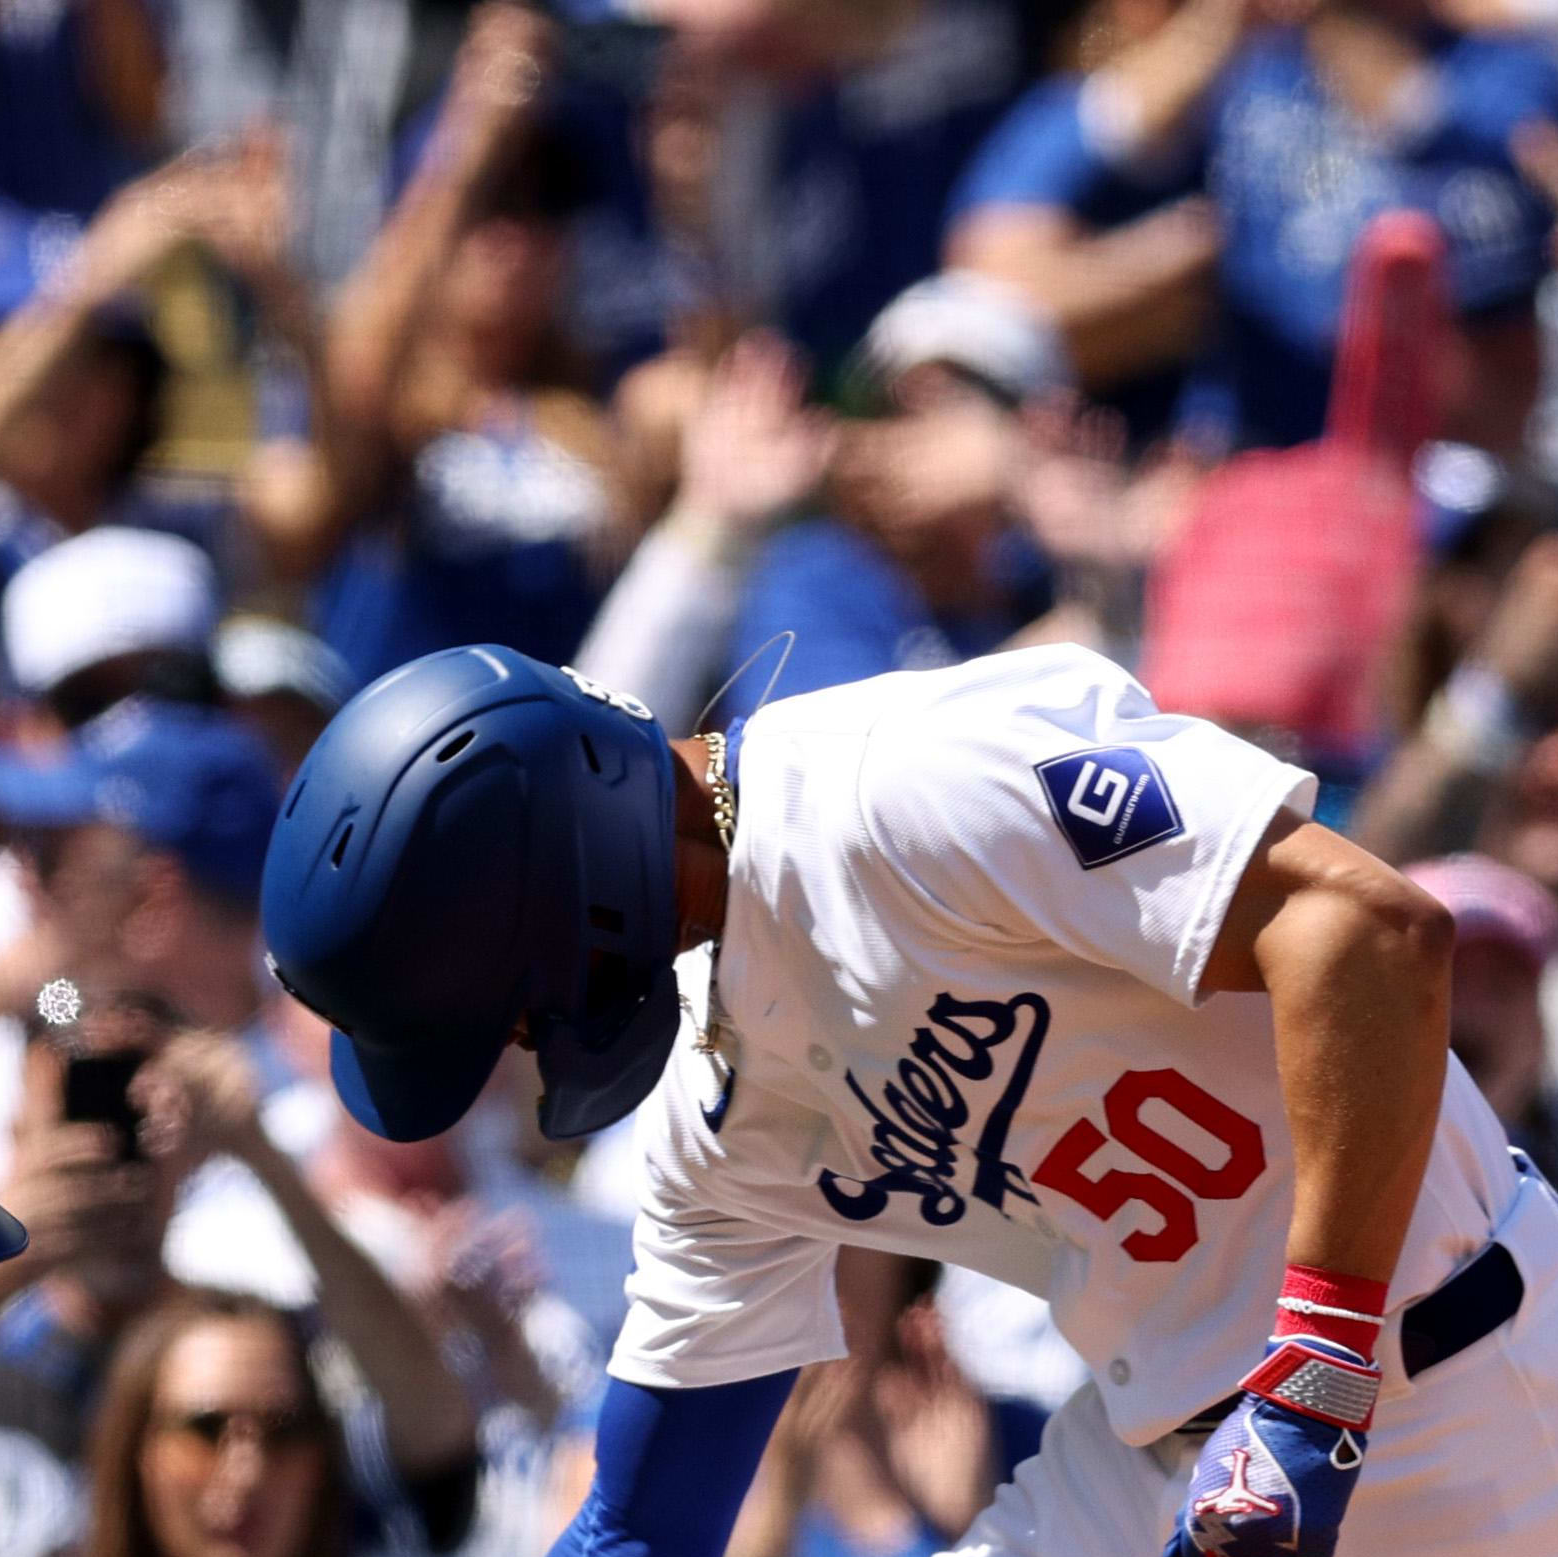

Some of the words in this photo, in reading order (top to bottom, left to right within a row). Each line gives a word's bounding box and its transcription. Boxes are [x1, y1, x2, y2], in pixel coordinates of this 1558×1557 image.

[1067, 760, 1130, 827] G
[1112, 773, 1151, 845] GUGGENHEIM
[1030, 1067, 1267, 1262] 50
